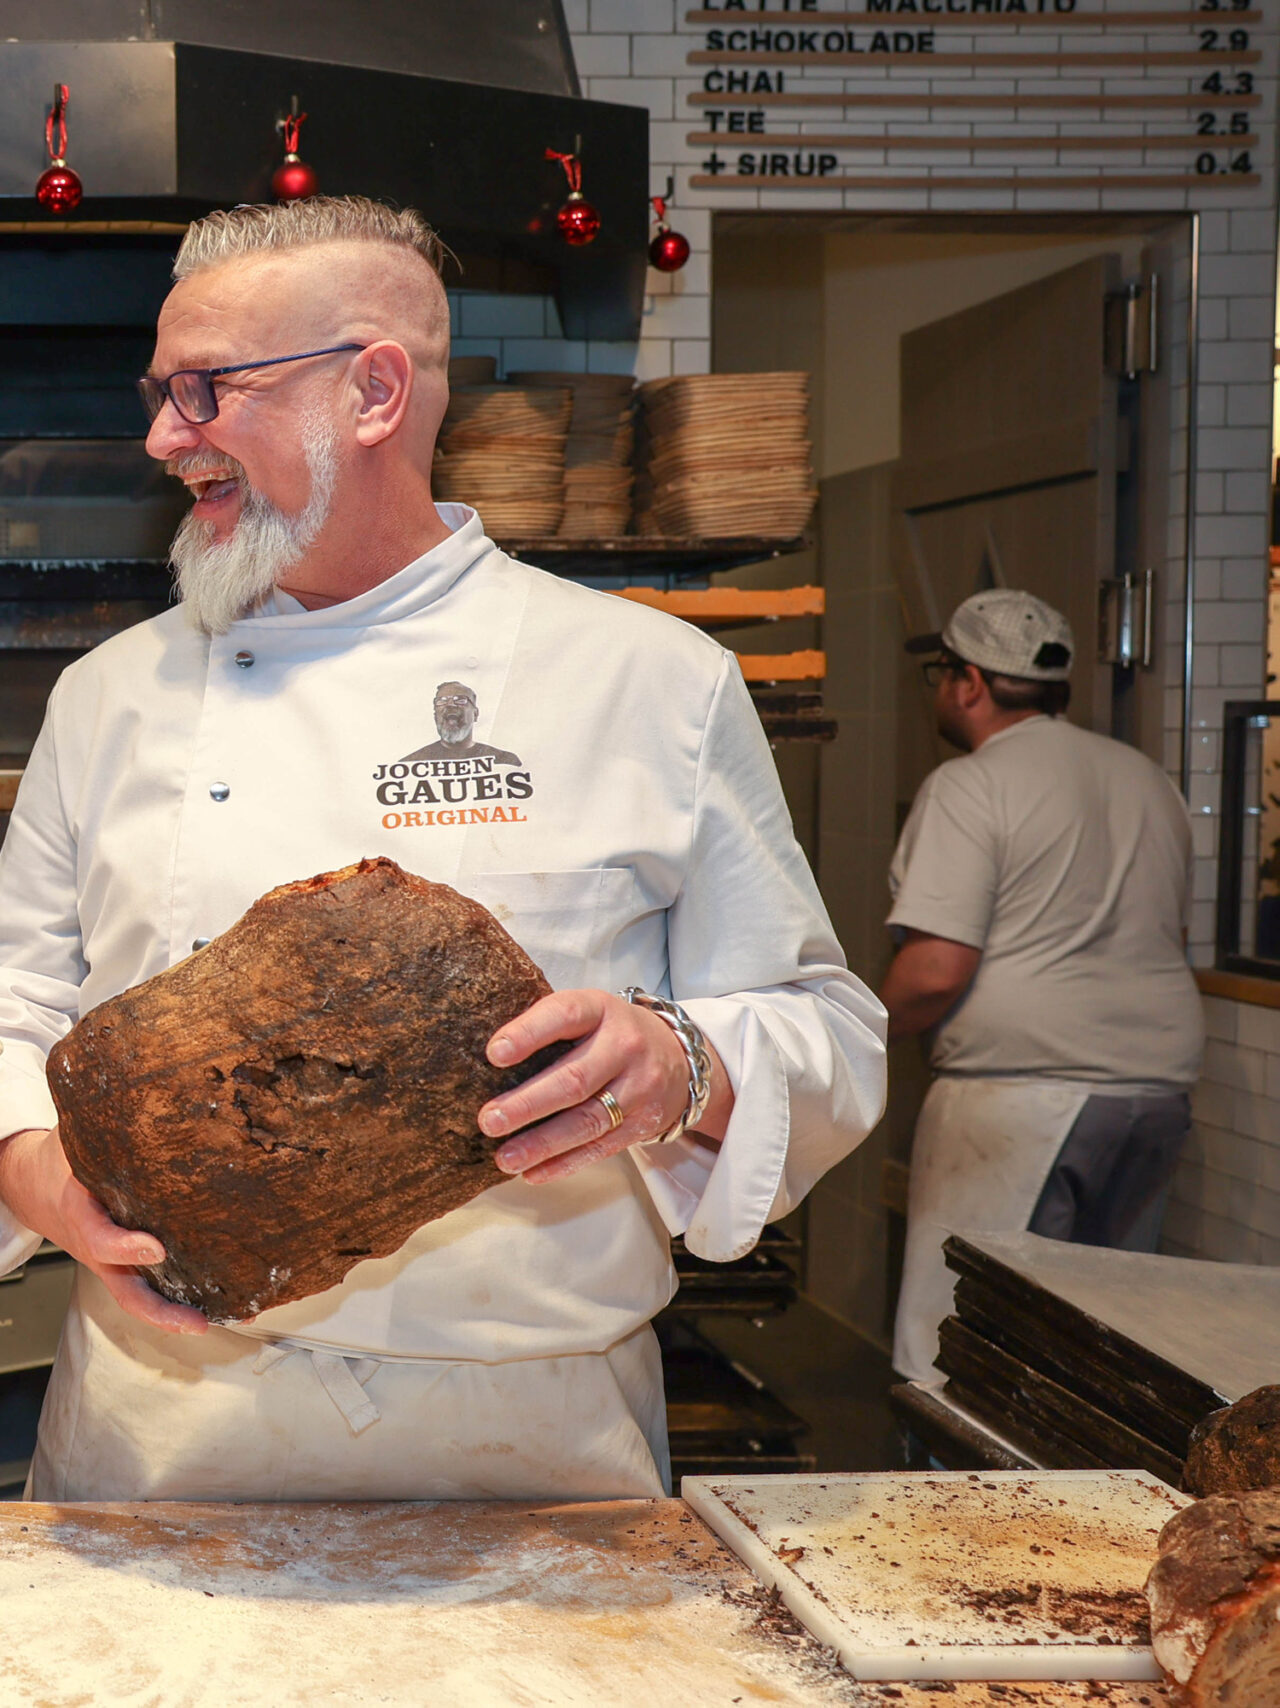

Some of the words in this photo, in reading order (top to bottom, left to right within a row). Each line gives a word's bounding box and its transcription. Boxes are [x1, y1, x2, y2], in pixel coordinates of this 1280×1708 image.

[706, 30, 935, 53] SCHOKOLADE
[1199, 30, 1249, 51] 2.9
[704, 70, 784, 94] CHAI
[1202, 71, 1254, 95] 4.3
[705, 111, 765, 134] TEE
[1197, 112, 1250, 136] 2.5
[738, 154, 838, 177] SIRUP
[1196, 152, 1252, 175] 0.4
[372, 757, 494, 780] JOCHEN
[376, 772, 534, 806] GAUES
[381, 806, 528, 830] ORIGINAL
